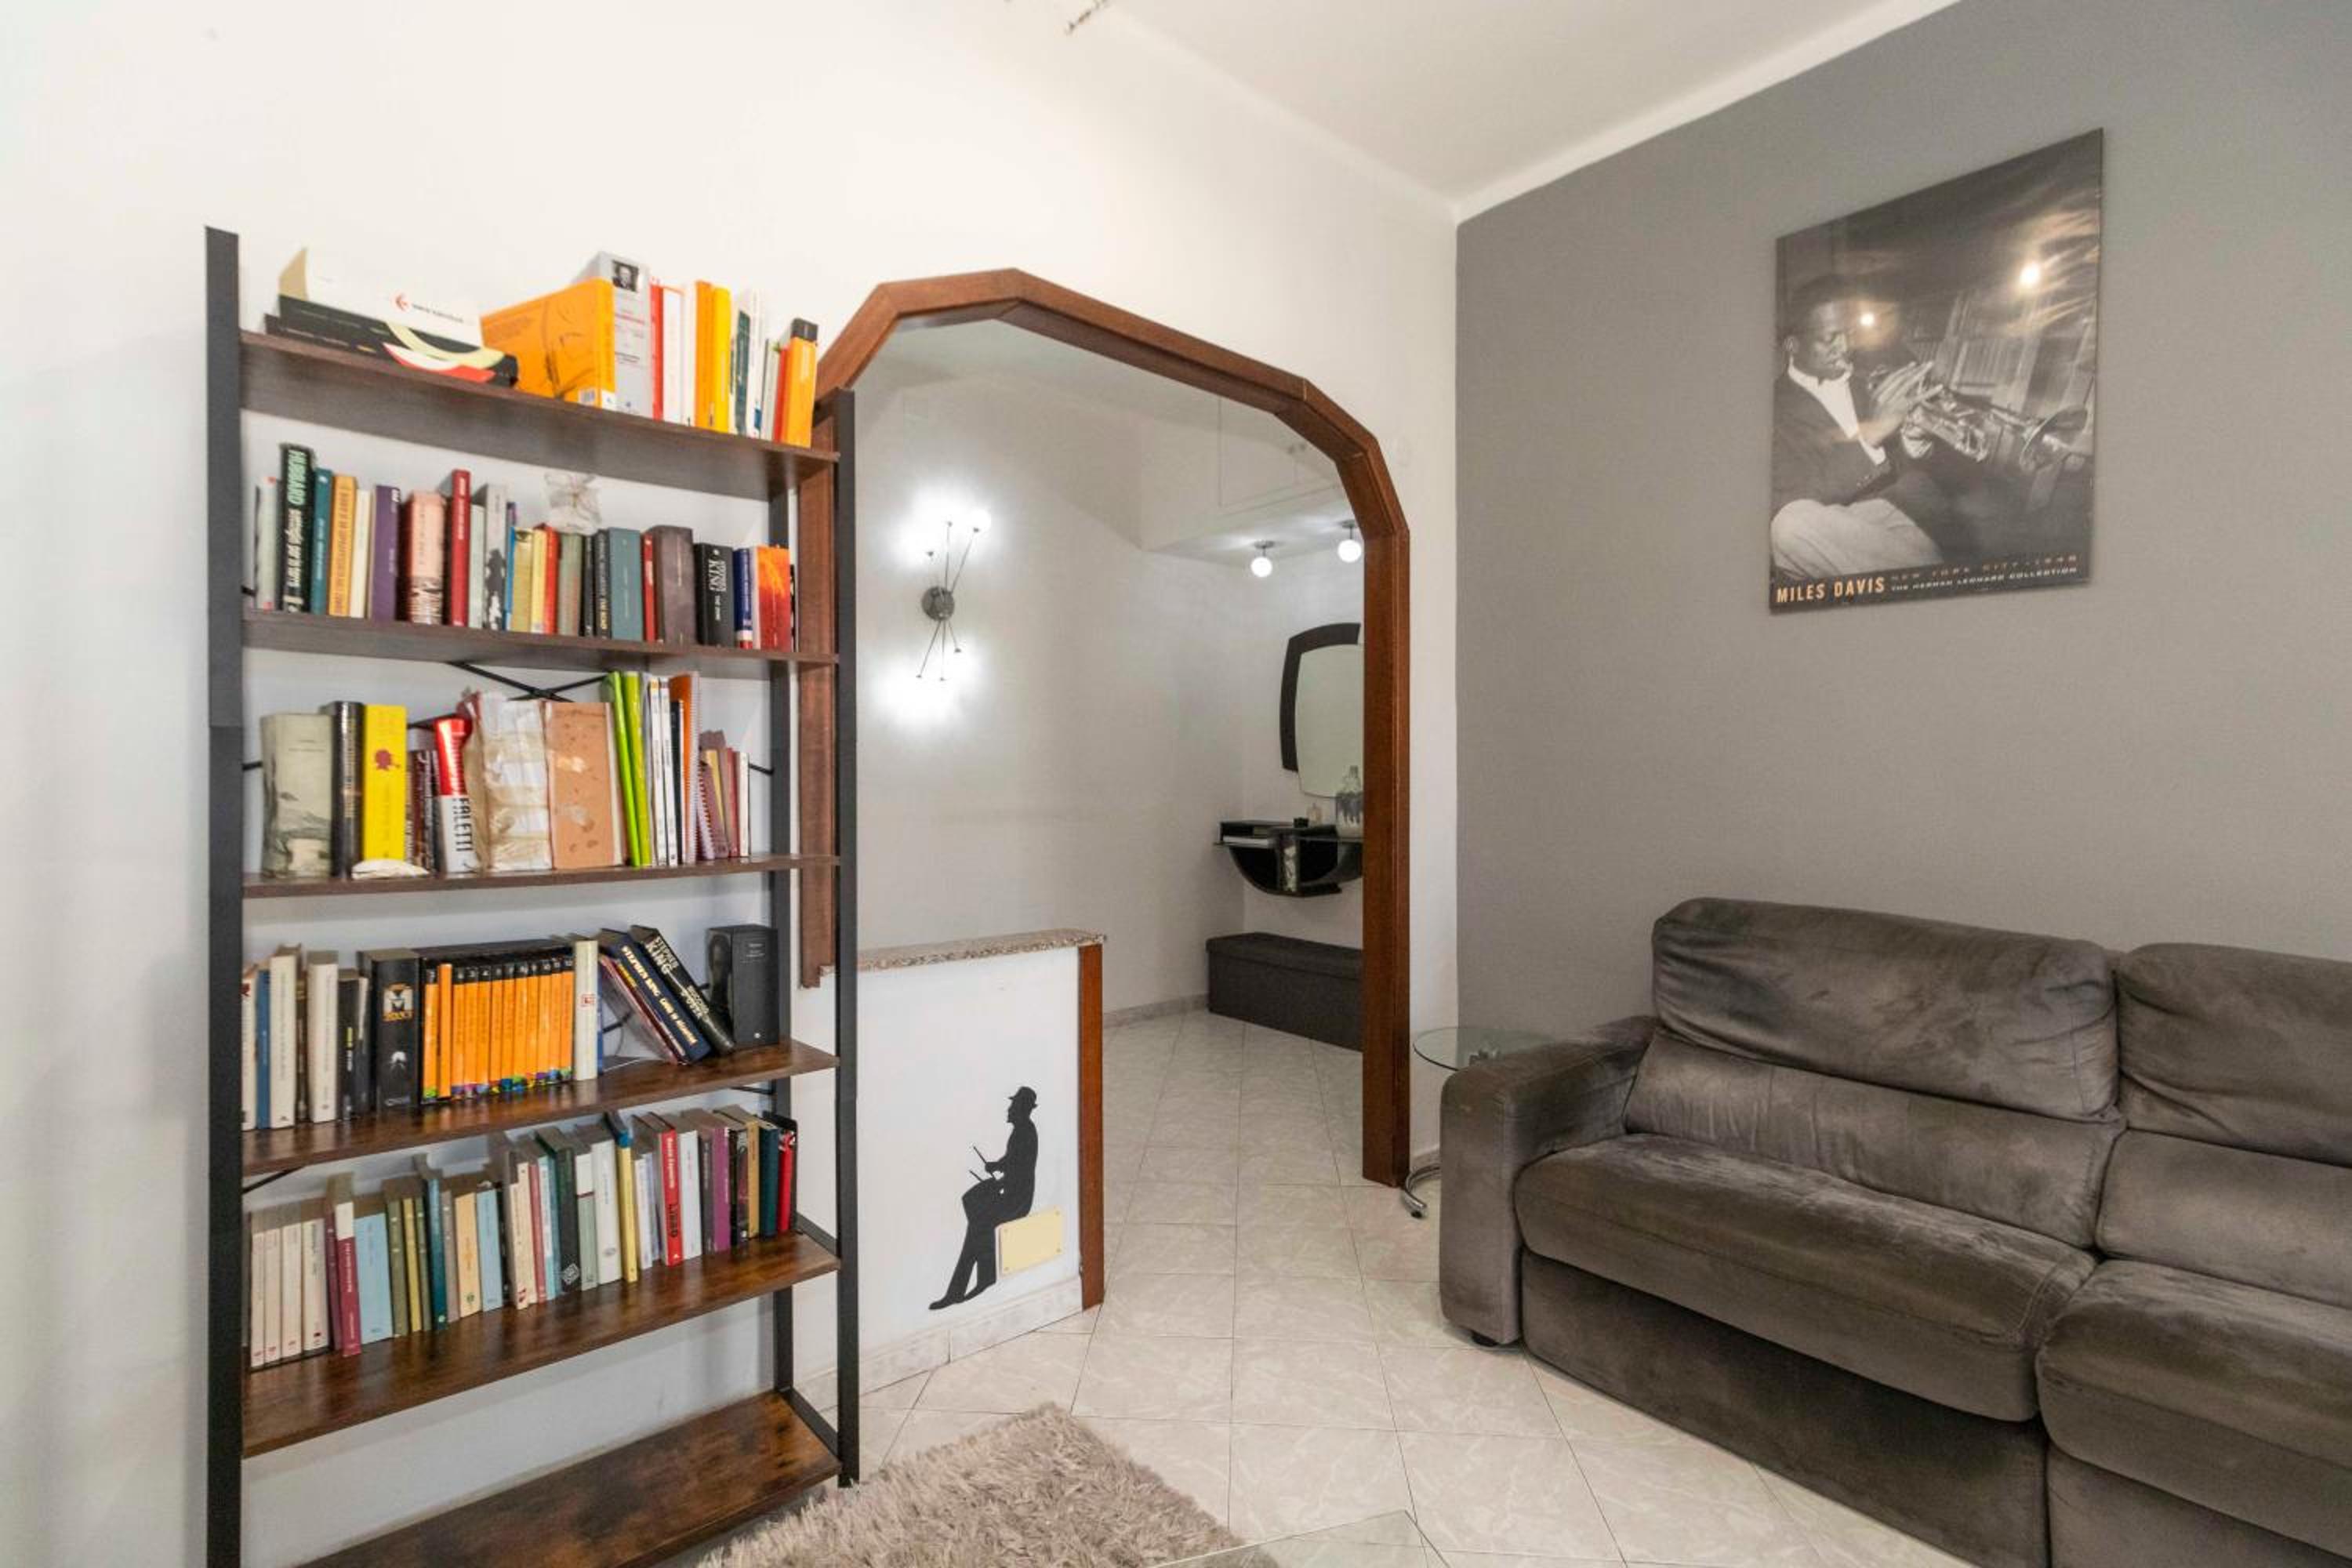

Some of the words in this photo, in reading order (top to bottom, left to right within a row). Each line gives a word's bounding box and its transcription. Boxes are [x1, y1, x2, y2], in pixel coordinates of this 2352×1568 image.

[287, 449, 308, 505] HUBBARD
[709, 558, 719, 591] KING
[1777, 583, 1826, 602] MILES
[1834, 576, 1885, 597] DAVIS
[1913, 580, 1953, 589] HERMAN
[2009, 567, 2077, 579] COLLECTION
[453, 798, 474, 851] FALETTI
[644, 940, 673, 975] KING
[654, 936, 680, 969] STEPHEN
